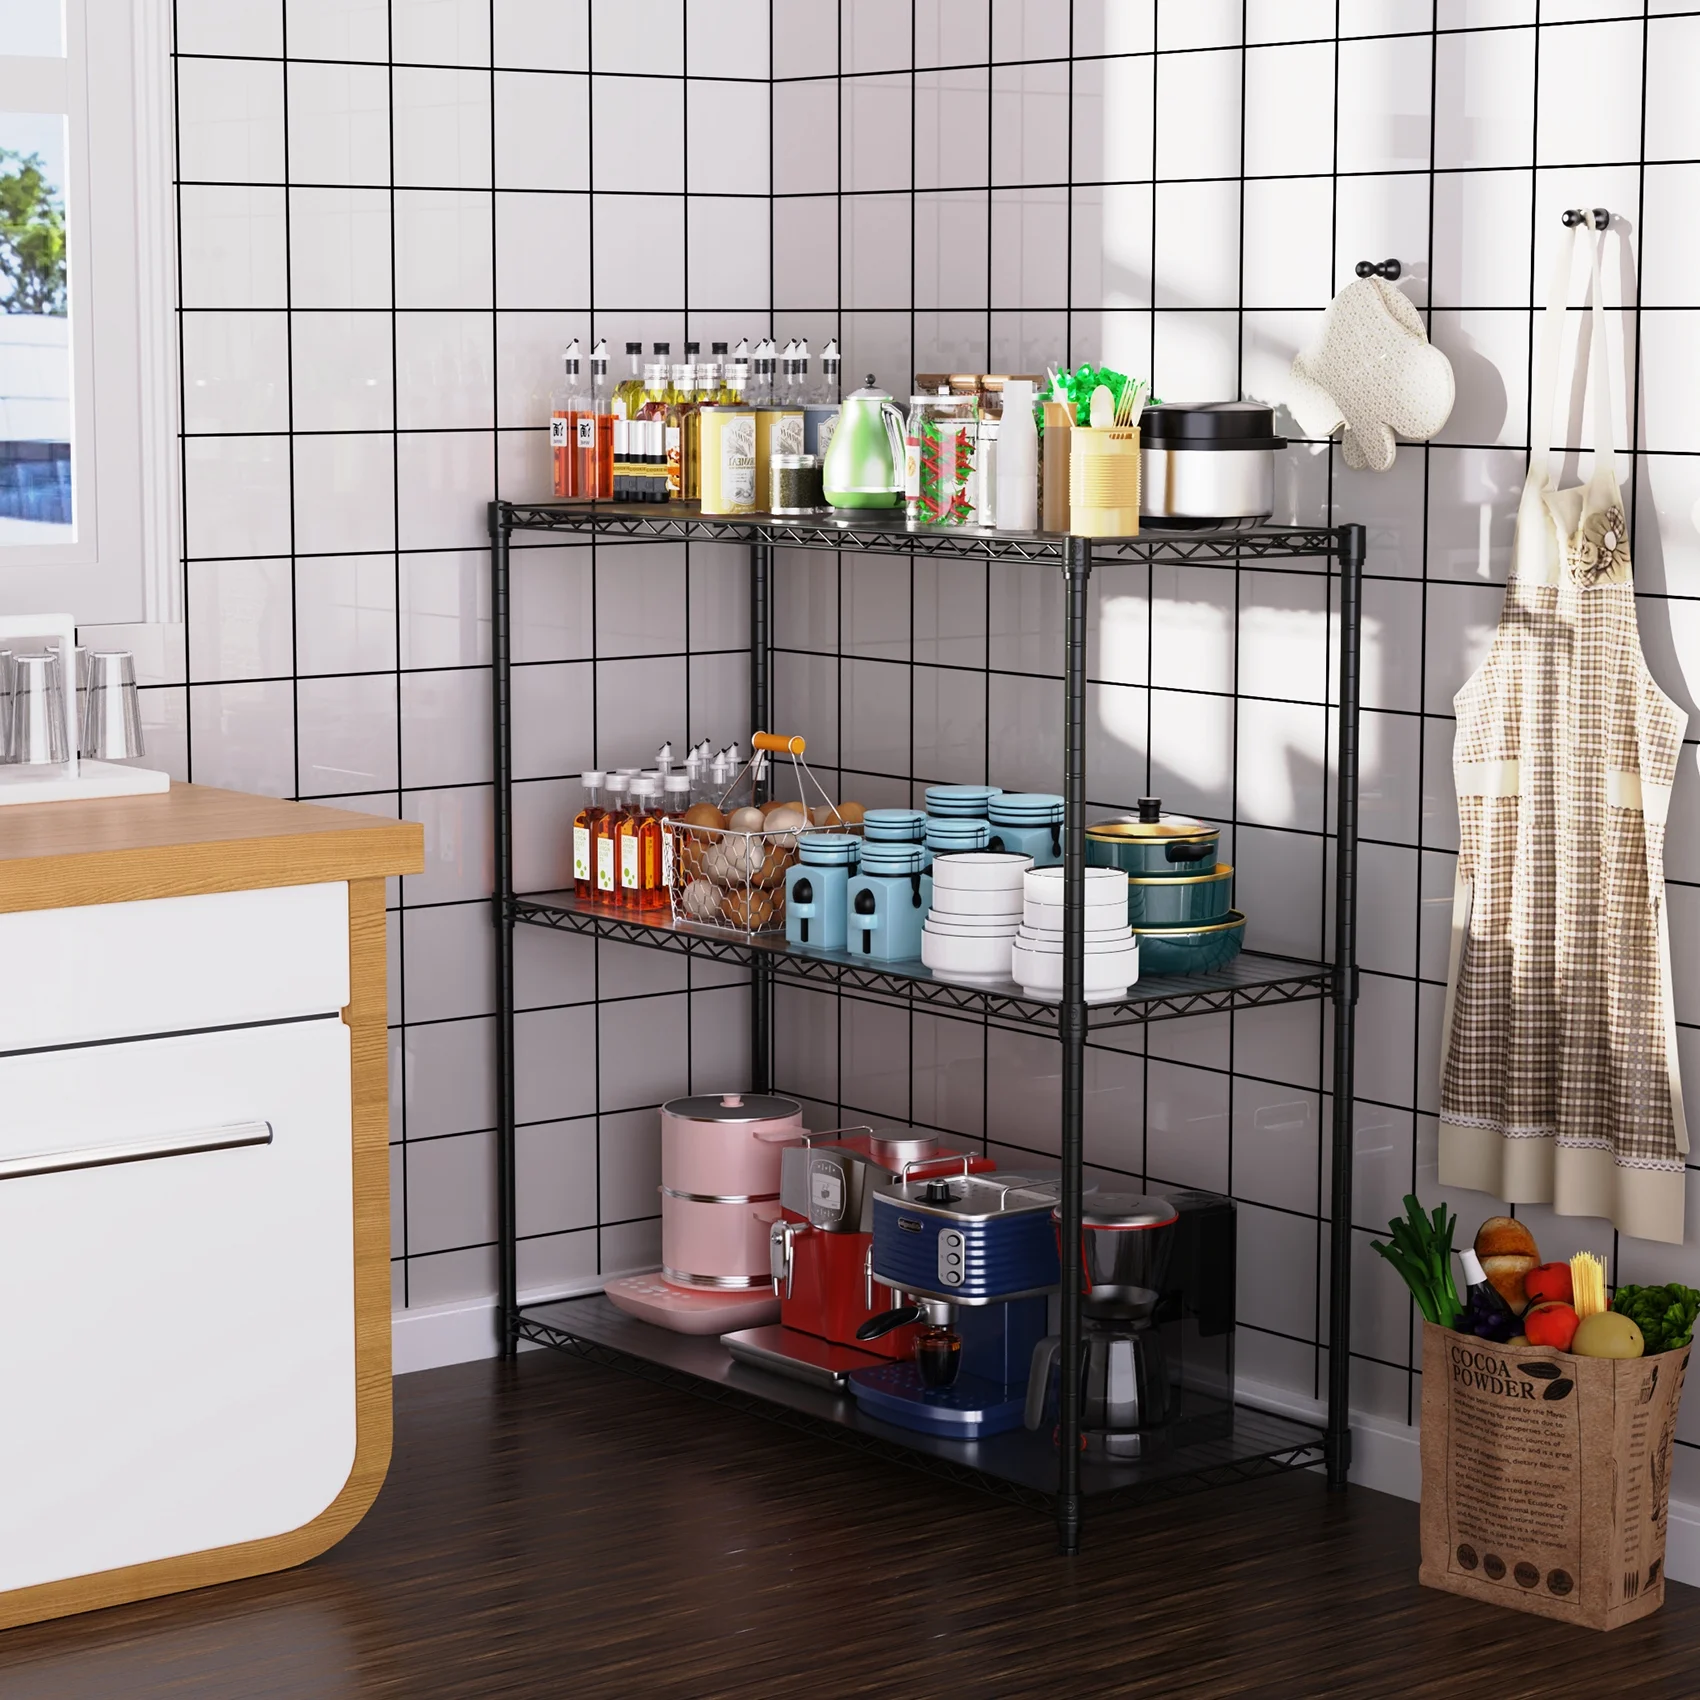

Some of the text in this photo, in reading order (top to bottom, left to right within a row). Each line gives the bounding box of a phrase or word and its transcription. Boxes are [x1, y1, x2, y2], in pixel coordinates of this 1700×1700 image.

[1451, 1346, 1511, 1379] COCOA
[1452, 1363, 1536, 1400] POWDER
[1490, 1403, 1521, 1412] consumed
[1546, 1410, 1567, 1419] Mayan
[1508, 1416, 1539, 1424] centuries
[1544, 1430, 1565, 1438] Cacao
[1512, 1459, 1538, 1467] dietary
[1534, 1480, 1551, 1488] from
[1524, 1490, 1555, 1498] premium
[1531, 1510, 1564, 1522] processing
[1536, 1521, 1564, 1529] nutrients
